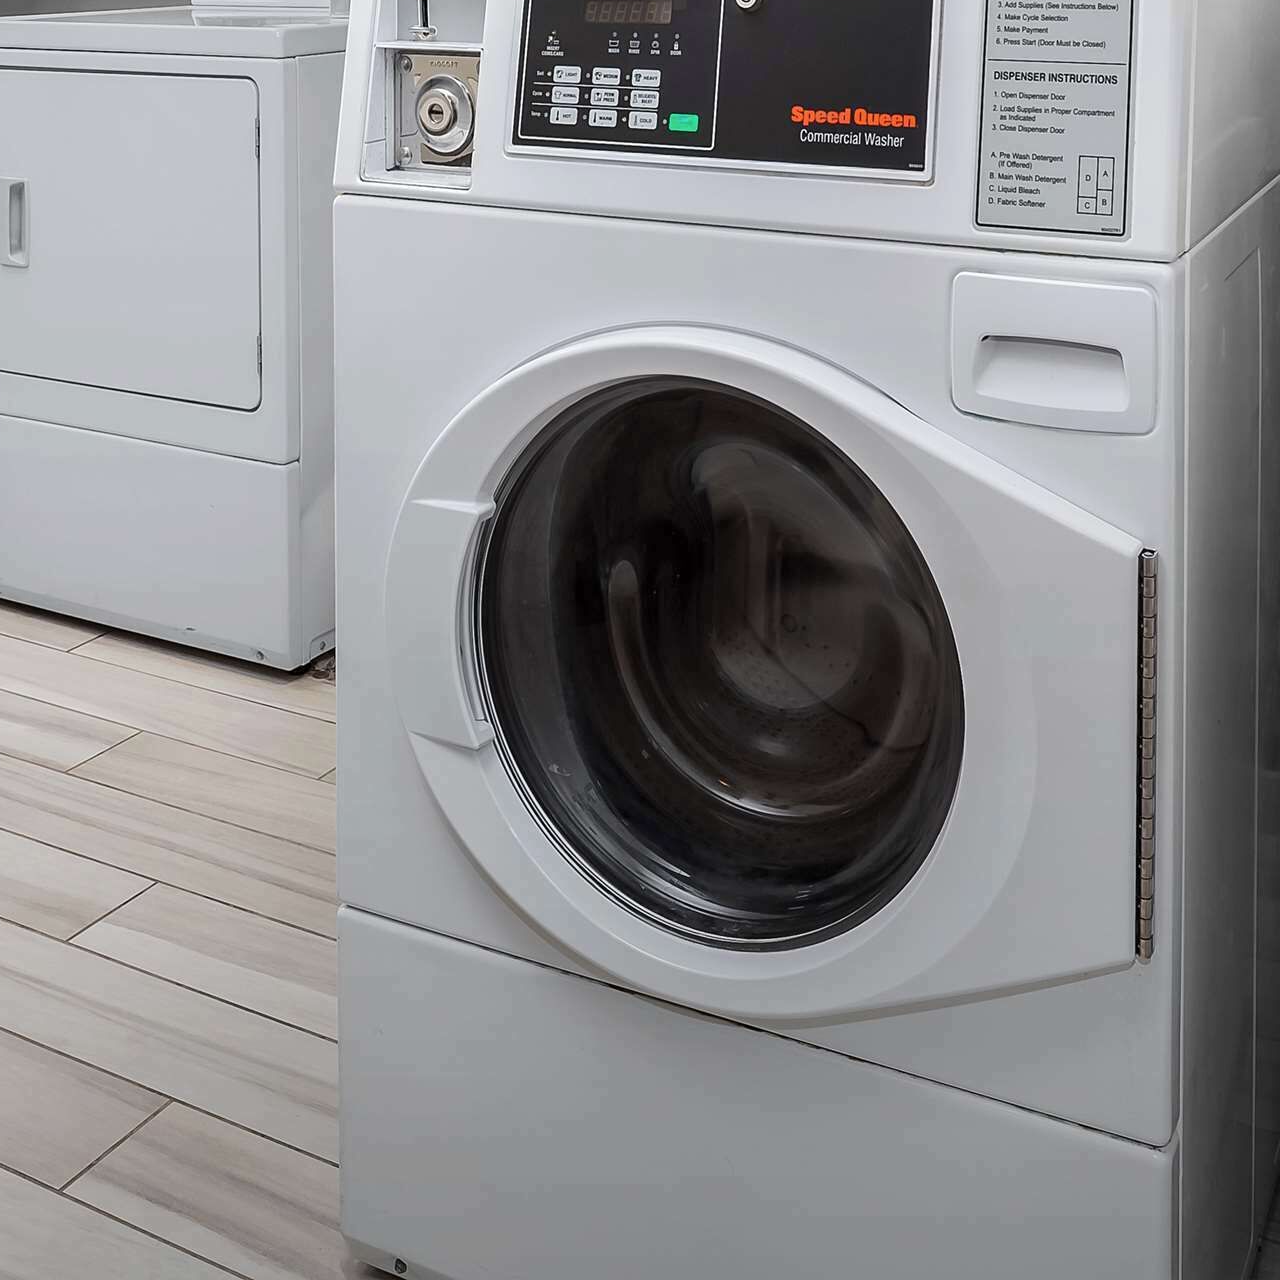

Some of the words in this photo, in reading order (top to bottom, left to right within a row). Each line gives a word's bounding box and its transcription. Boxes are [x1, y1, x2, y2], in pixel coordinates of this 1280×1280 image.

[1004, 1, 1017, 9] Add
[1017, 1, 1044, 11] Supplies
[1045, 2, 1060, 11] (See
[1061, 2, 1096, 11] Instructions
[1097, 2, 1119, 12] Below)
[1022, 14, 1039, 22] Cycle
[1040, 14, 1069, 22] Selection
[1021, 26, 1049, 35] Payment
[1003, 38, 1021, 46] Press
[1037, 39, 1055, 47] (Door
[1081, 40, 1106, 49] Closed)
[993, 70, 1046, 82] DISPENSER
[1048, 72, 1118, 85] INSTRUCTIONS
[1000, 91, 1018, 99] Open
[1018, 92, 1049, 101] Dispenser
[1050, 93, 1066, 101] Door
[791, 105, 851, 126] Speed
[853, 108, 917, 128] Queen
[1000, 105, 1016, 113] Load
[1016, 106, 1043, 115] Supplies
[1043, 106, 1050, 114] in
[1051, 107, 1072, 116] Proper
[1073, 108, 1115, 118] Compartment
[1008, 114, 1036, 122] Indicated
[999, 124, 1017, 132] Close
[1017, 124, 1049, 134] Dispenser
[1049, 126, 1065, 134] Door
[799, 128, 862, 145] Commercial
[864, 132, 905, 148] Washer
[999, 151, 1011, 159] Pre
[1011, 152, 1030, 160] Wash
[1031, 153, 1064, 163] Detergent
[1006, 161, 1033, 170] Offered)
[997, 172, 1014, 181] Main
[1015, 174, 1033, 182] Wash
[1034, 174, 1067, 184] Detergent
[1085, 174, 1092, 182] D
[997, 185, 1017, 194] Liquid
[1018, 186, 1041, 195] Bleach
[997, 197, 1017, 206] Fabric
[1018, 198, 1046, 208] Softener
[1084, 201, 1091, 209] C
